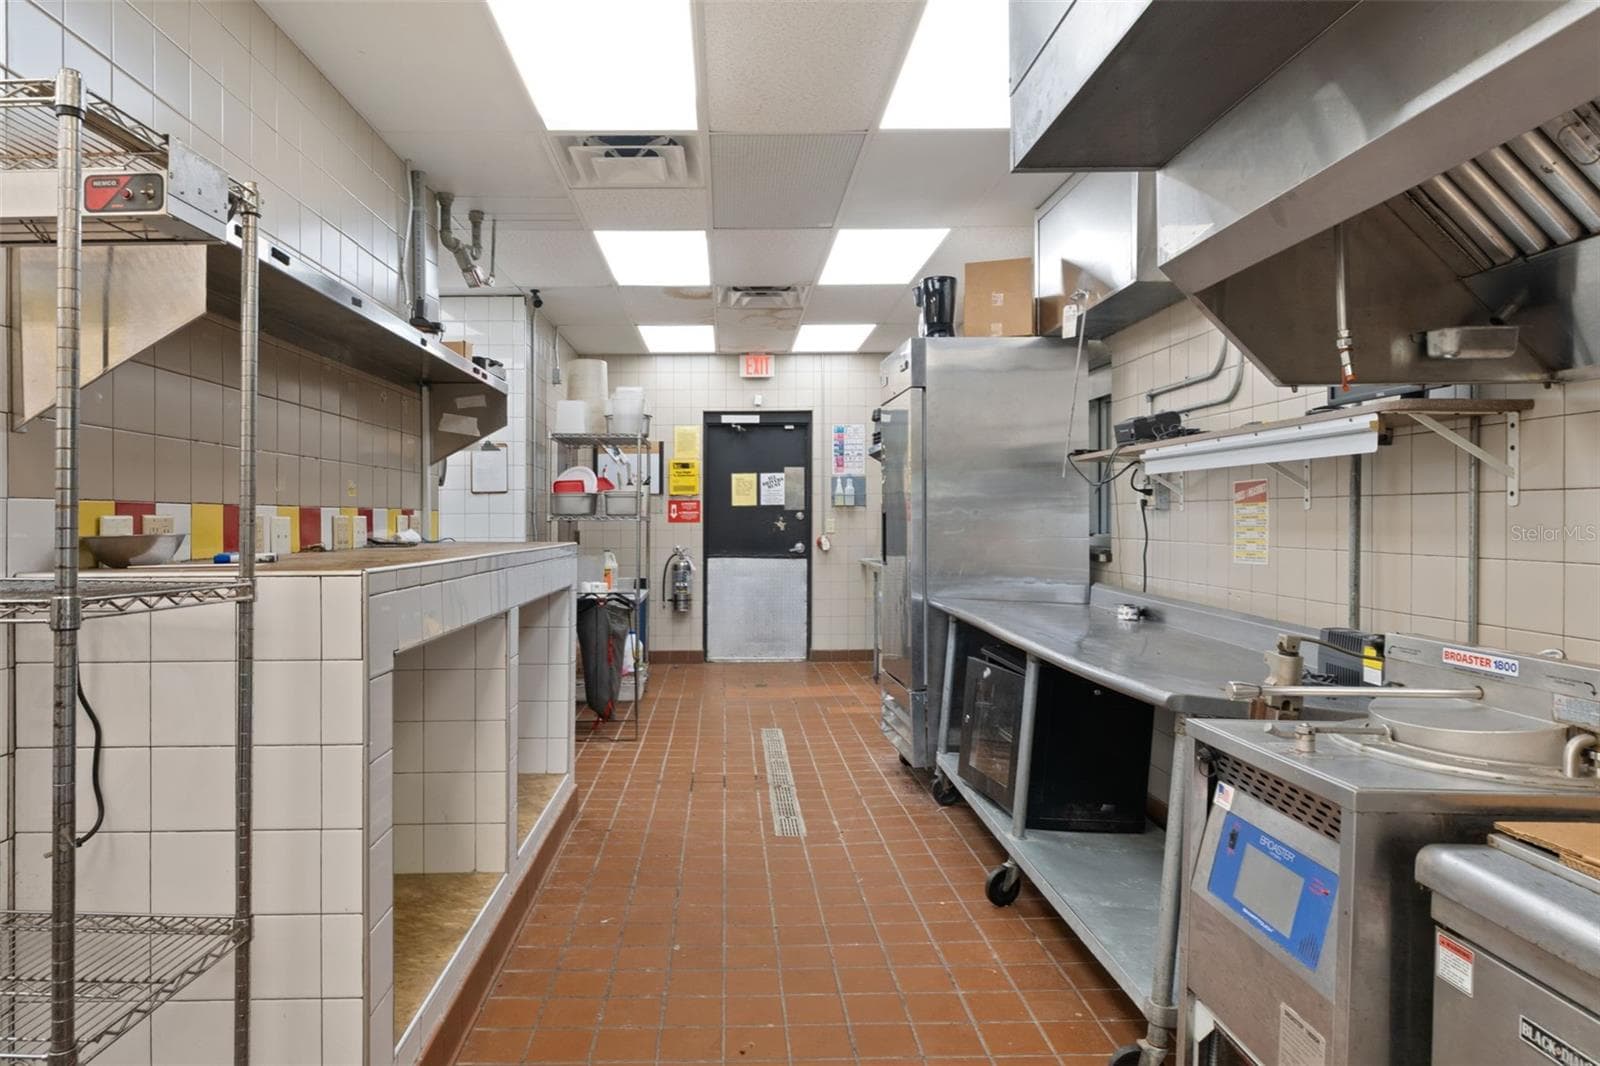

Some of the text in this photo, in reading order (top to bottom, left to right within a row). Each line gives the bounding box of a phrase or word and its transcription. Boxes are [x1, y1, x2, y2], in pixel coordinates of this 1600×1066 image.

[745, 354, 769, 375] EXIT
[1444, 650, 1492, 668] BROASTER
[1259, 835, 1296, 862] BROASTER
[1522, 1022, 1557, 1056] BLACK
